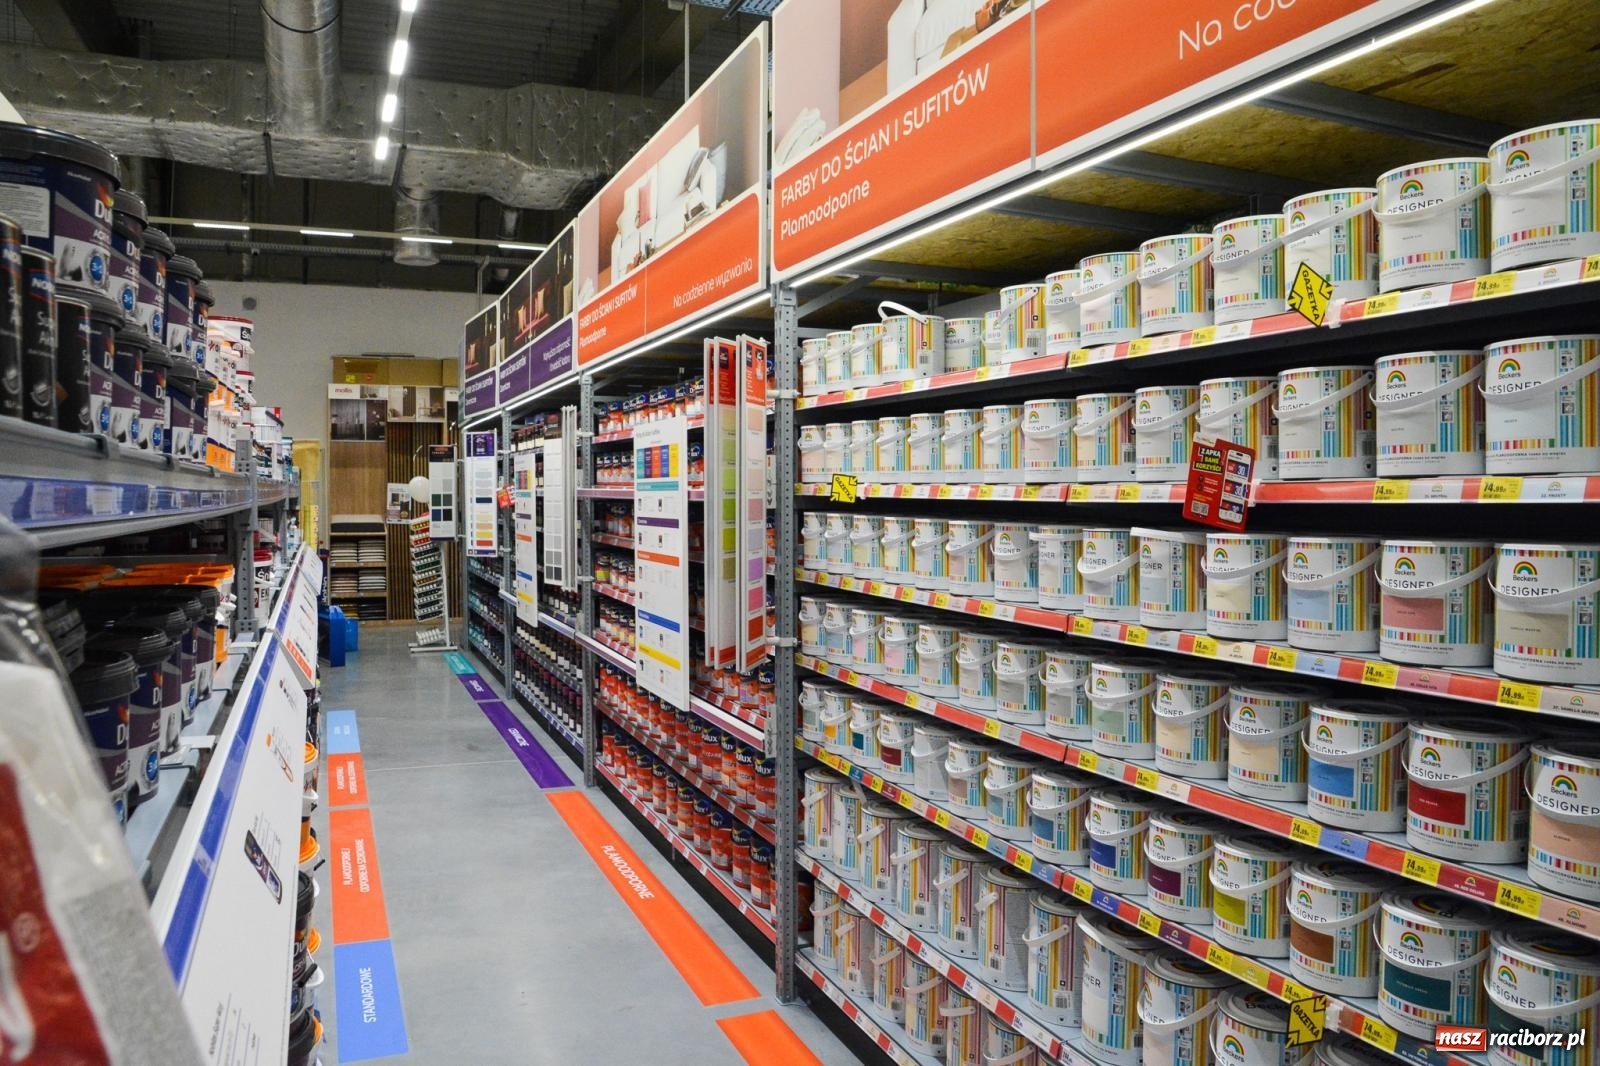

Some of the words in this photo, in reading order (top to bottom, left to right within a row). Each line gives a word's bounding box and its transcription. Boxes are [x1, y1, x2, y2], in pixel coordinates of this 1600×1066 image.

[1179, 19, 1222, 60] Na
[1233, 0, 1296, 31] co
[781, 168, 819, 208] FARBY
[821, 155, 841, 185] DO
[844, 124, 890, 171] ŚCIAN
[894, 124, 899, 142] I
[903, 63, 990, 136] SUFITÓW
[1400, 191, 1424, 201] Beckers
[781, 179, 870, 241] Plamoodporne
[715, 257, 753, 288] wyzwania
[1302, 270, 1320, 322] GAZETKA
[1378, 391, 1424, 401] ESIGN
[835, 477, 854, 501] GAZETKA
[1394, 569, 1416, 577] Beckers
[1513, 574, 1538, 583] Beckers
[1420, 758, 1441, 768] Beckers
[1550, 786, 1577, 798] Beckers
[601, 844, 655, 899] PLAMOODPORNE
[1400, 942, 1424, 953] Beckers
[359, 967, 377, 1024] STANDARDOWE
[1293, 1004, 1319, 1037] GAZETKA
